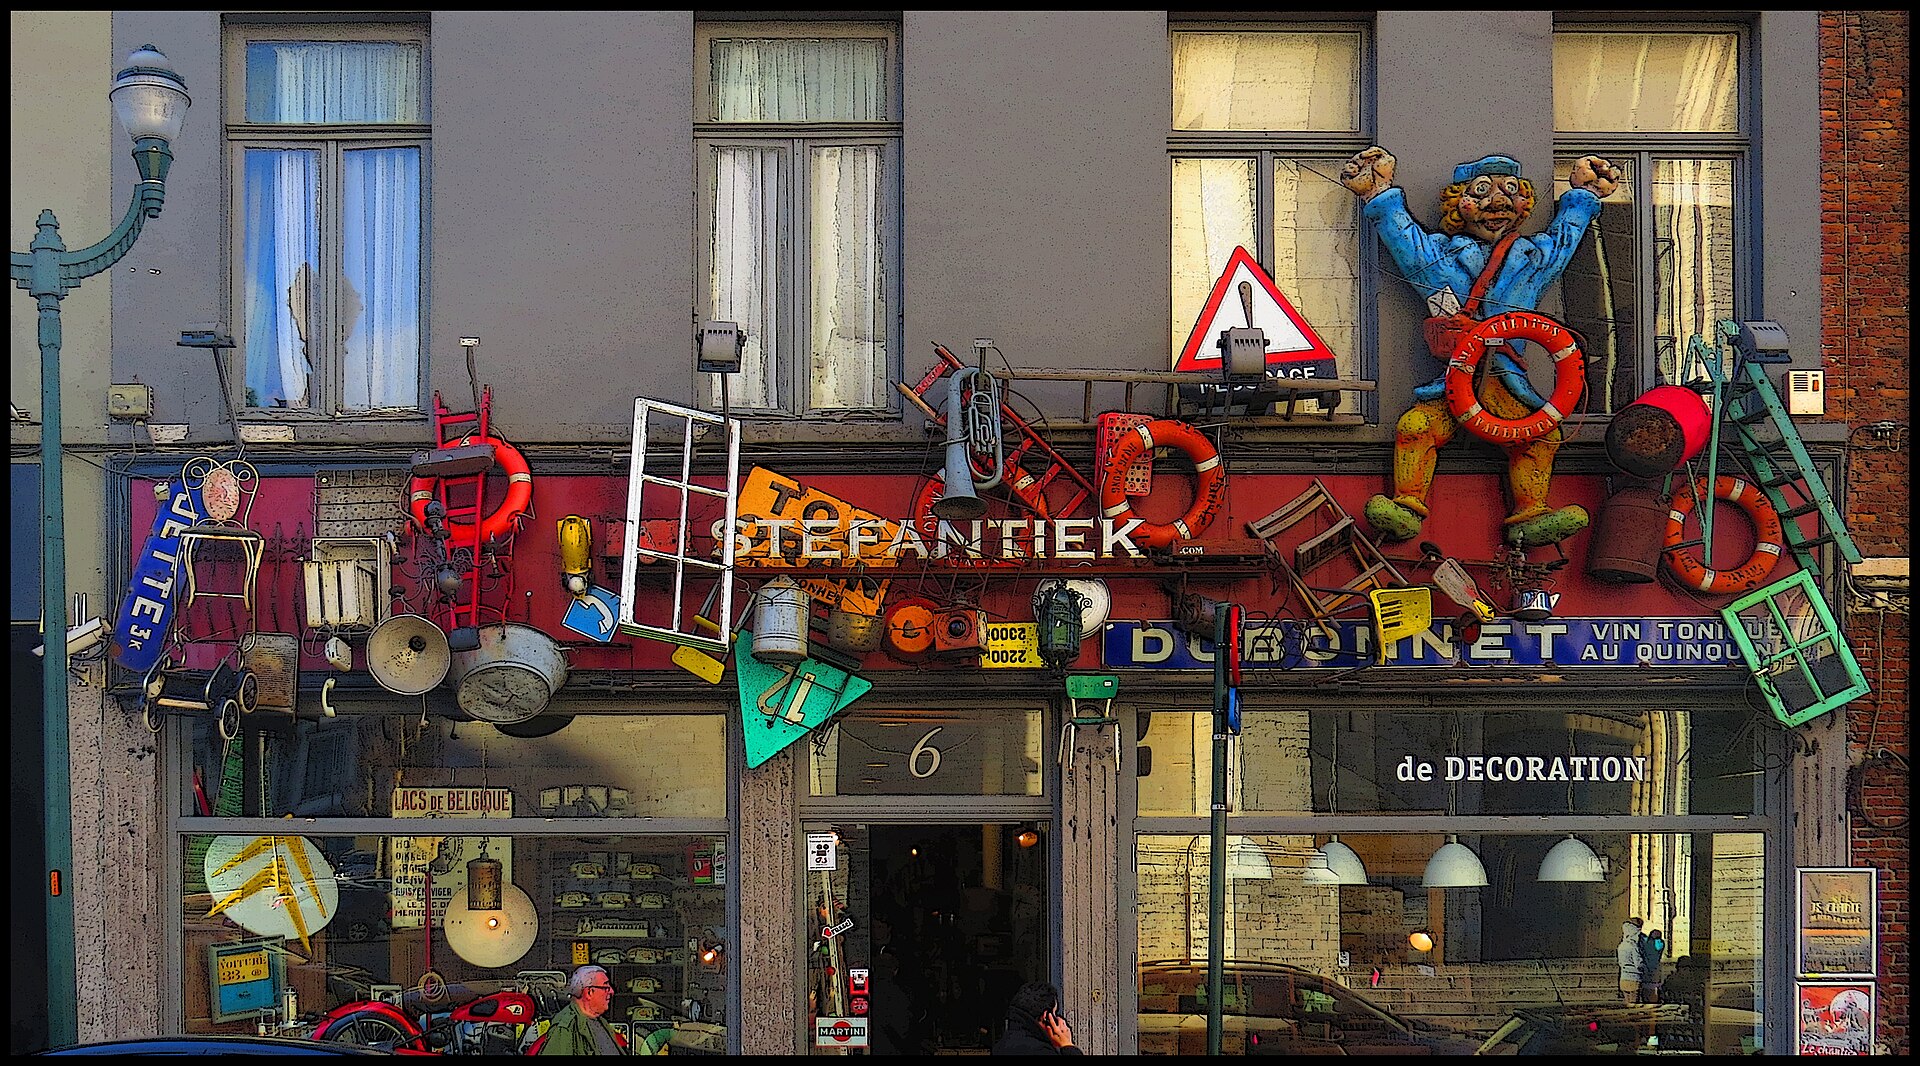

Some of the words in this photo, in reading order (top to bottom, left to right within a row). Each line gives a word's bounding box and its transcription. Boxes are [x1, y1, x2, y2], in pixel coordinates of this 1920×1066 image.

[1474, 416, 1554, 439] VALLETTA
[710, 518, 1148, 559] STEFANTIEK
[130, 492, 199, 625] JETTE
[1591, 623, 1641, 640] VIN
[1657, 623, 1783, 640] TONIUE
[1581, 644, 1619, 661] AU
[907, 725, 944, 779] 6
[1396, 756, 1433, 781] de
[1444, 756, 1646, 781] DECORATION
[394, 790, 427, 811] LACS
[820, 1028, 864, 1036] MARTINI
